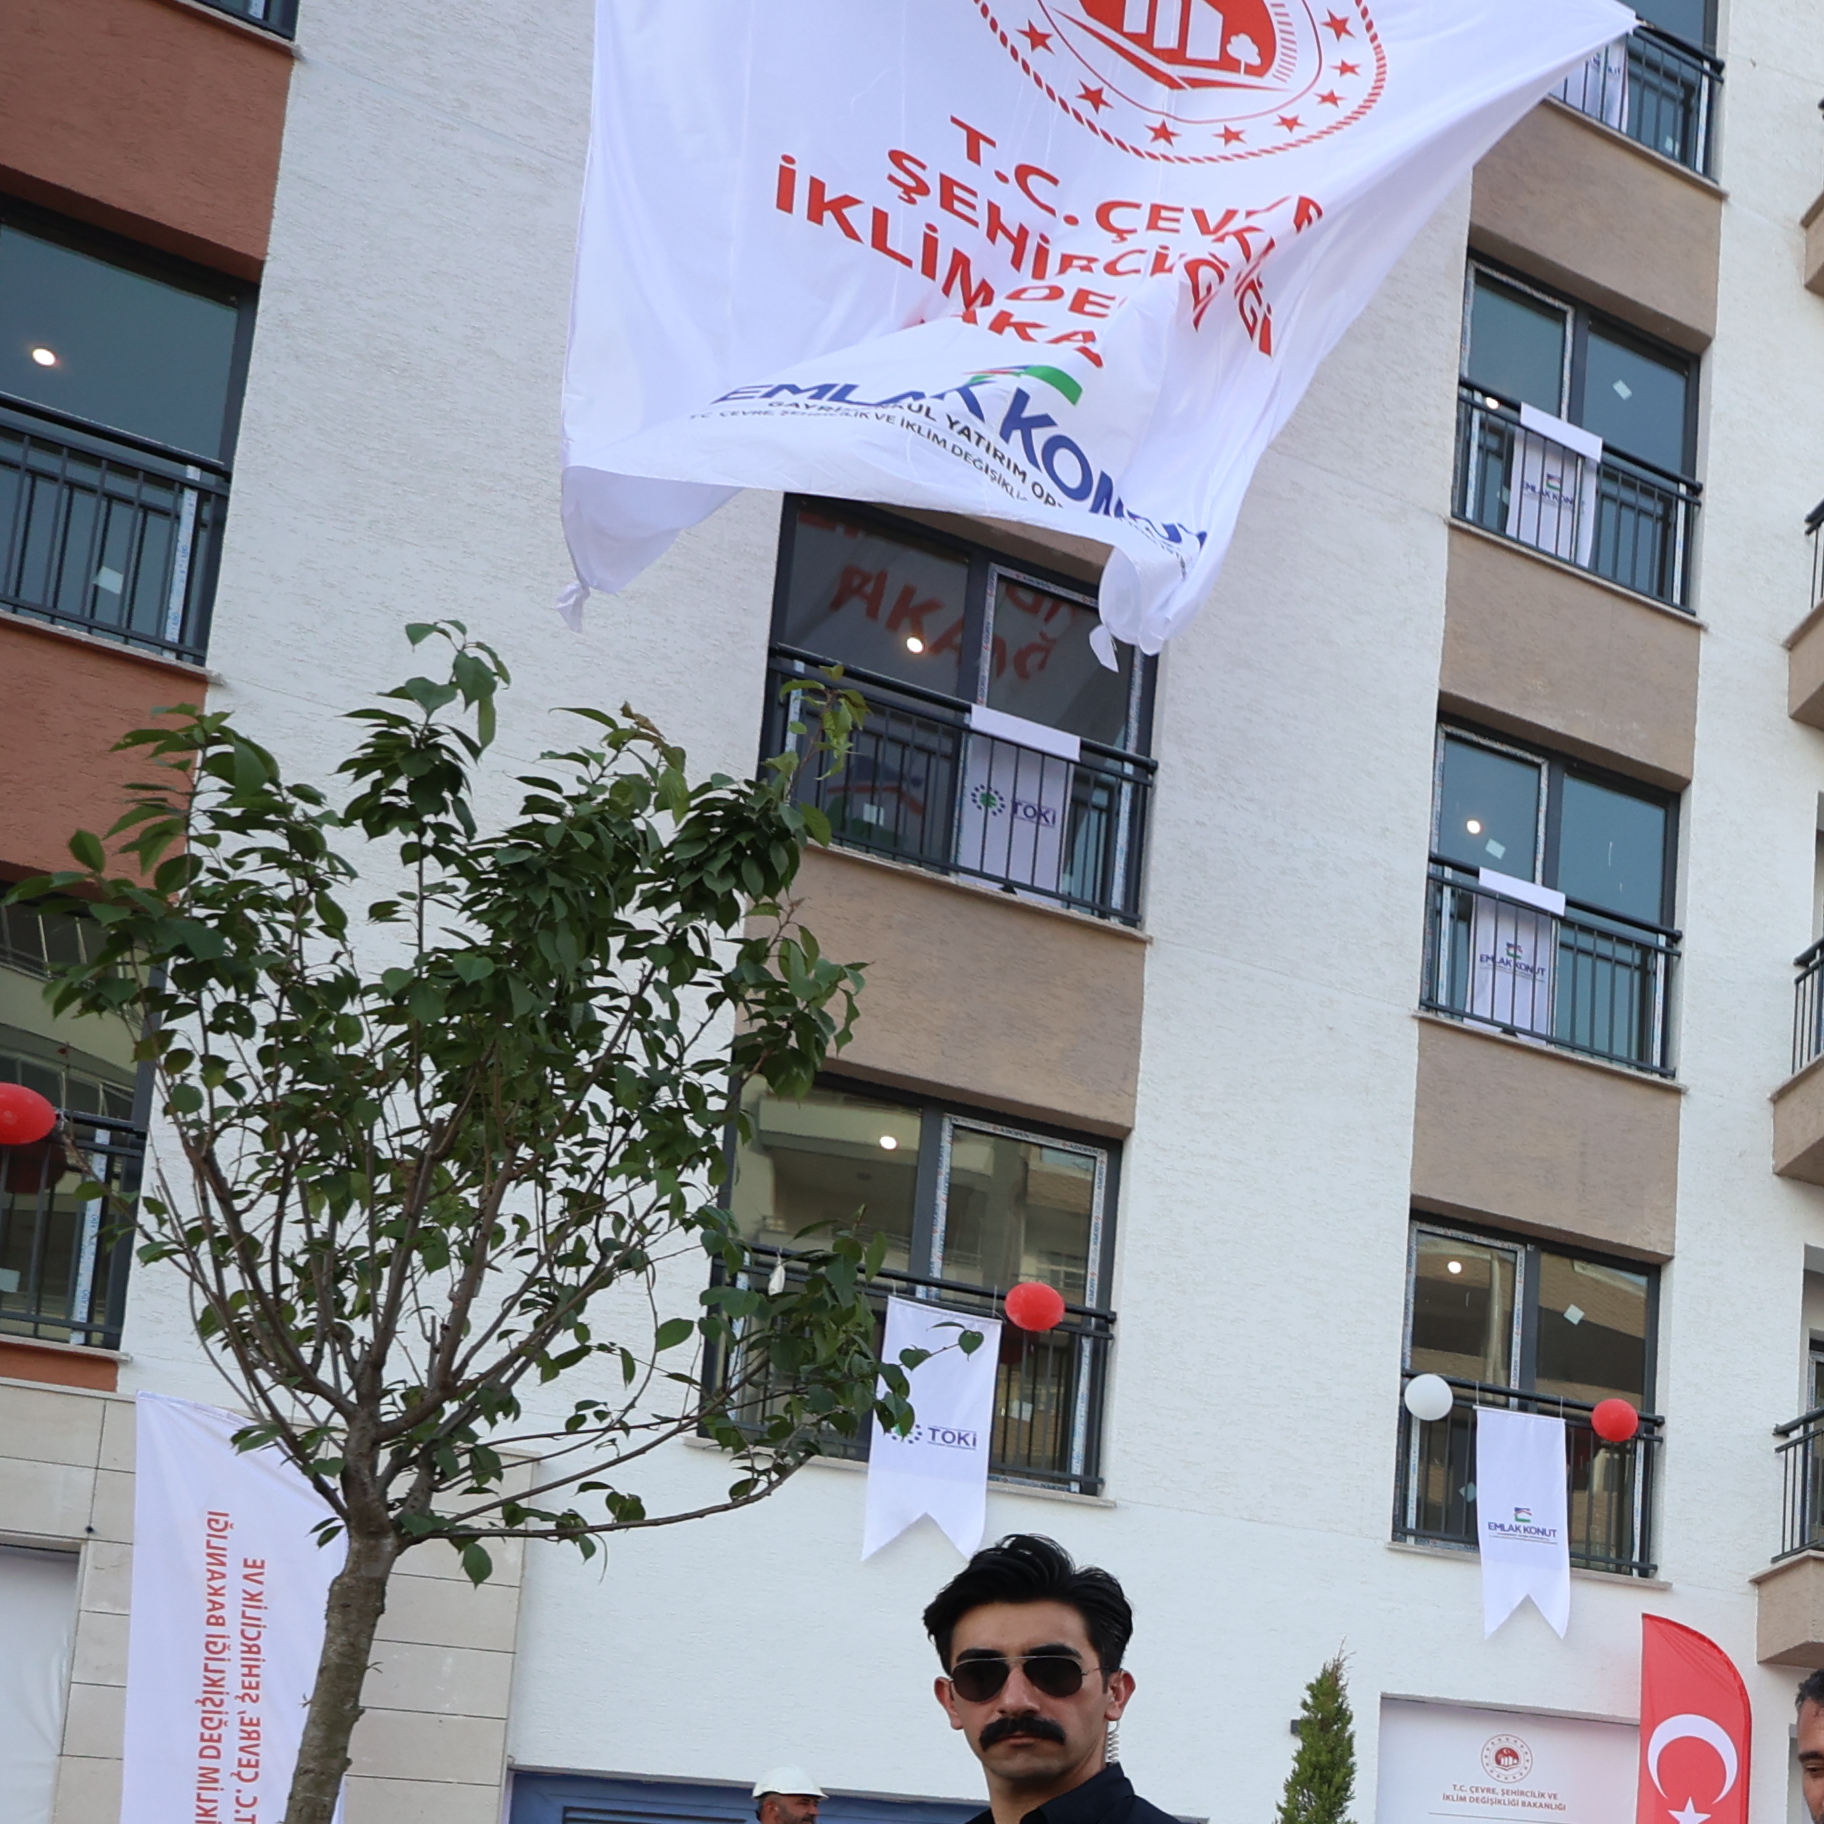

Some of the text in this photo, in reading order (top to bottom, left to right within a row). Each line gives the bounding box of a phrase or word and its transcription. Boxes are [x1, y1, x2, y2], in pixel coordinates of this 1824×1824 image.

[950, 115, 1079, 228] T.C.
[775, 154, 996, 314] İKLİM
[874, 412, 896, 426] VE
[900, 416, 947, 450] İKLİM
[945, 412, 1028, 484] YATIRIM
[1488, 1521, 1522, 1534] EMLAK
[1523, 1526, 1557, 1538] KONUT
[1547, 1792, 1558, 1801] VE
